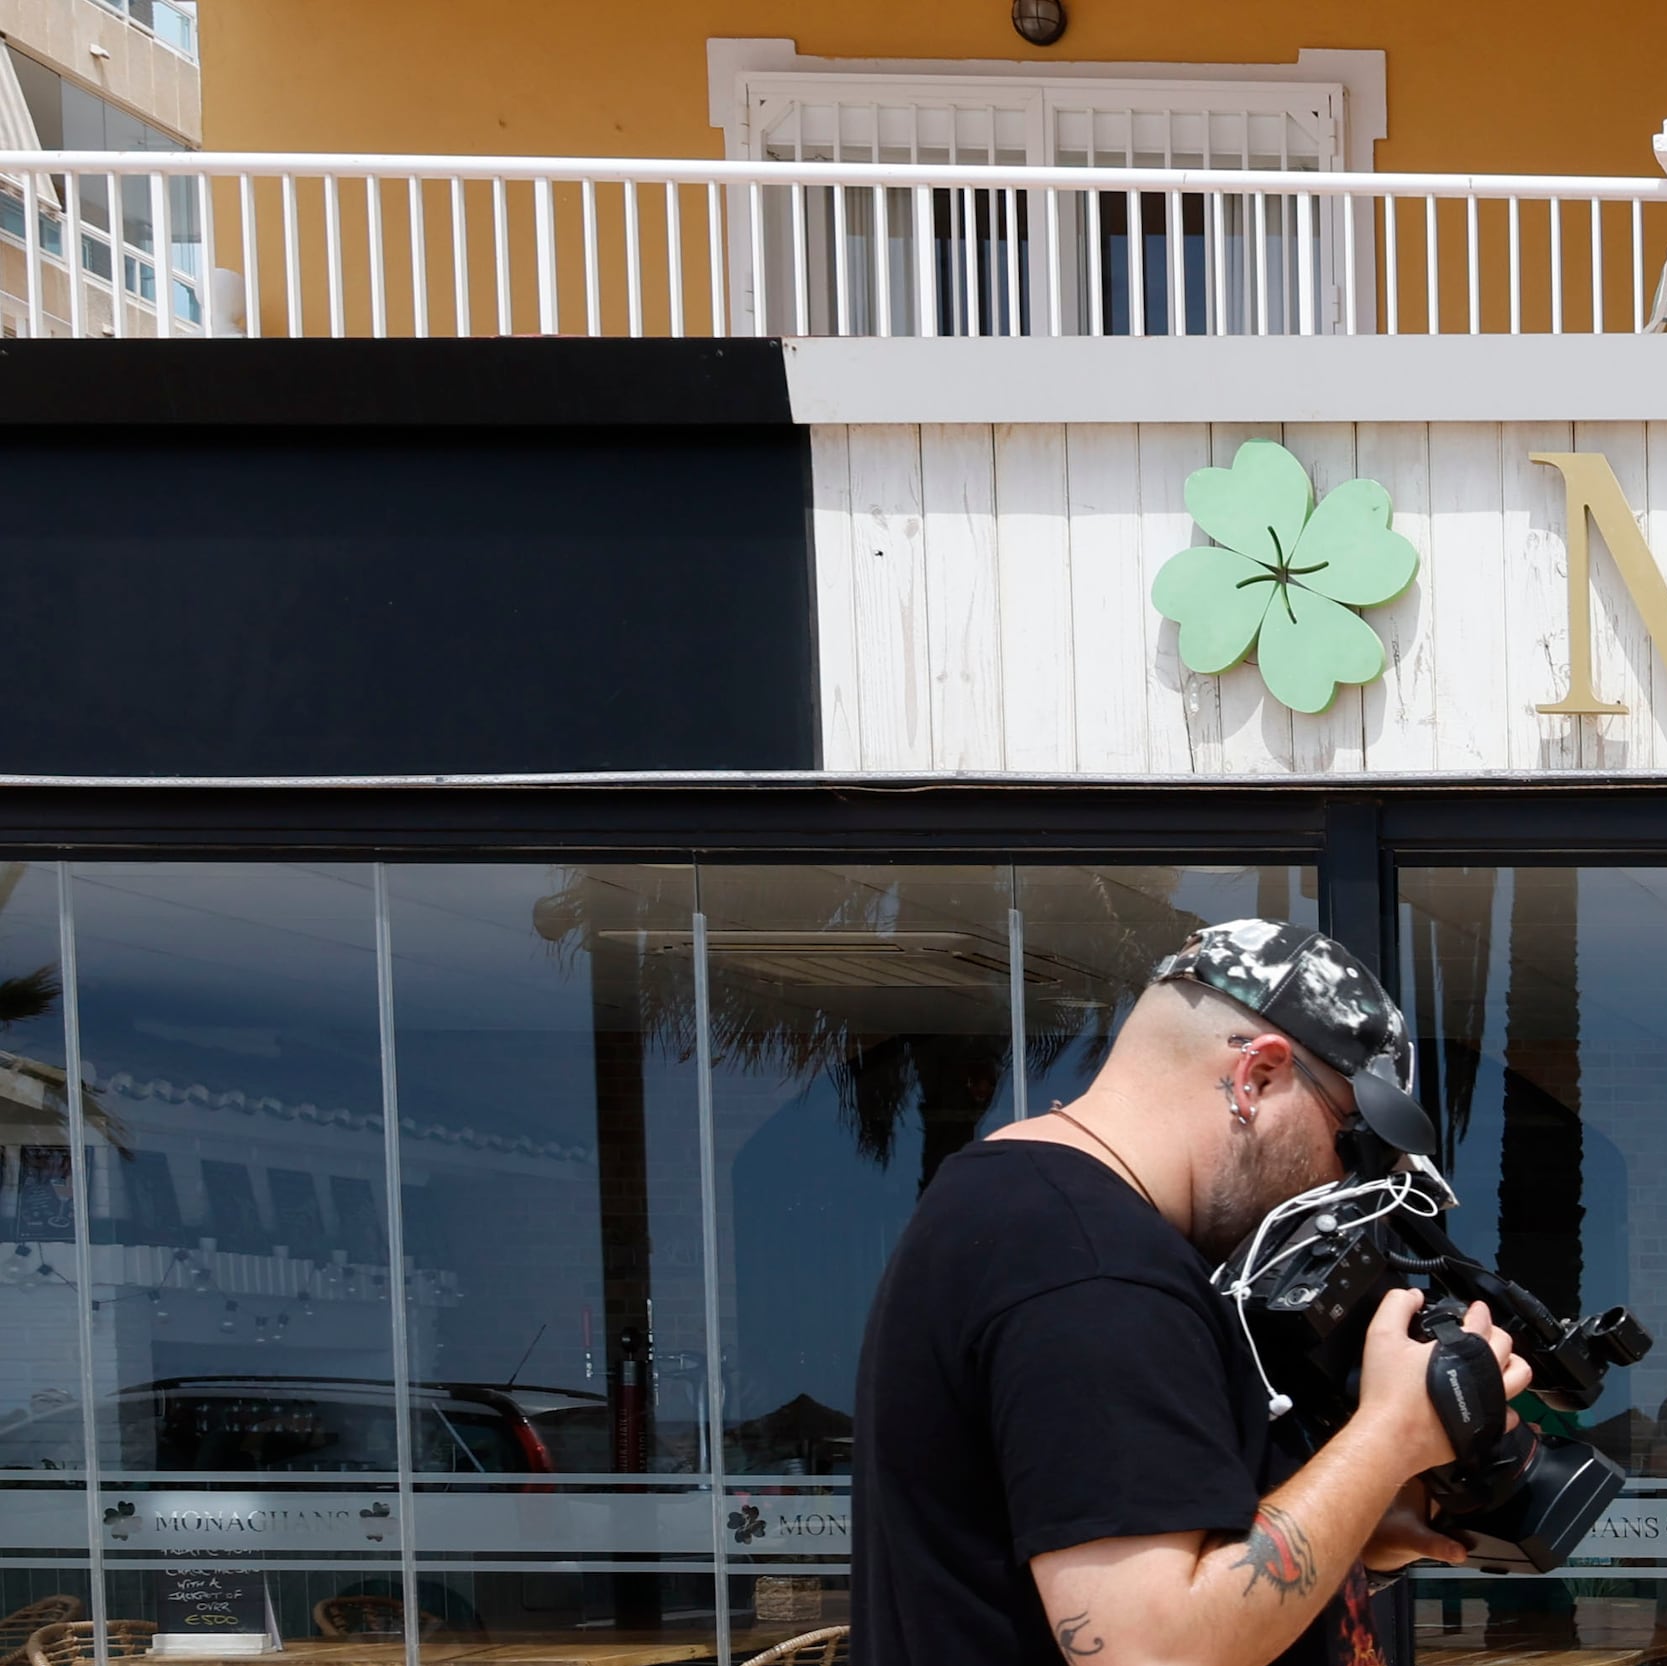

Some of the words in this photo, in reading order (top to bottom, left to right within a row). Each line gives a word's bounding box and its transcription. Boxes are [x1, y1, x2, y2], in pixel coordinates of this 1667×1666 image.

[1446, 1369, 1472, 1423] Panasonic
[177, 1579, 205, 1589] WITH
[168, 1590, 223, 1602] JACKPOT
[225, 1589, 243, 1599] OF
[184, 1614, 239, 1626] €500
